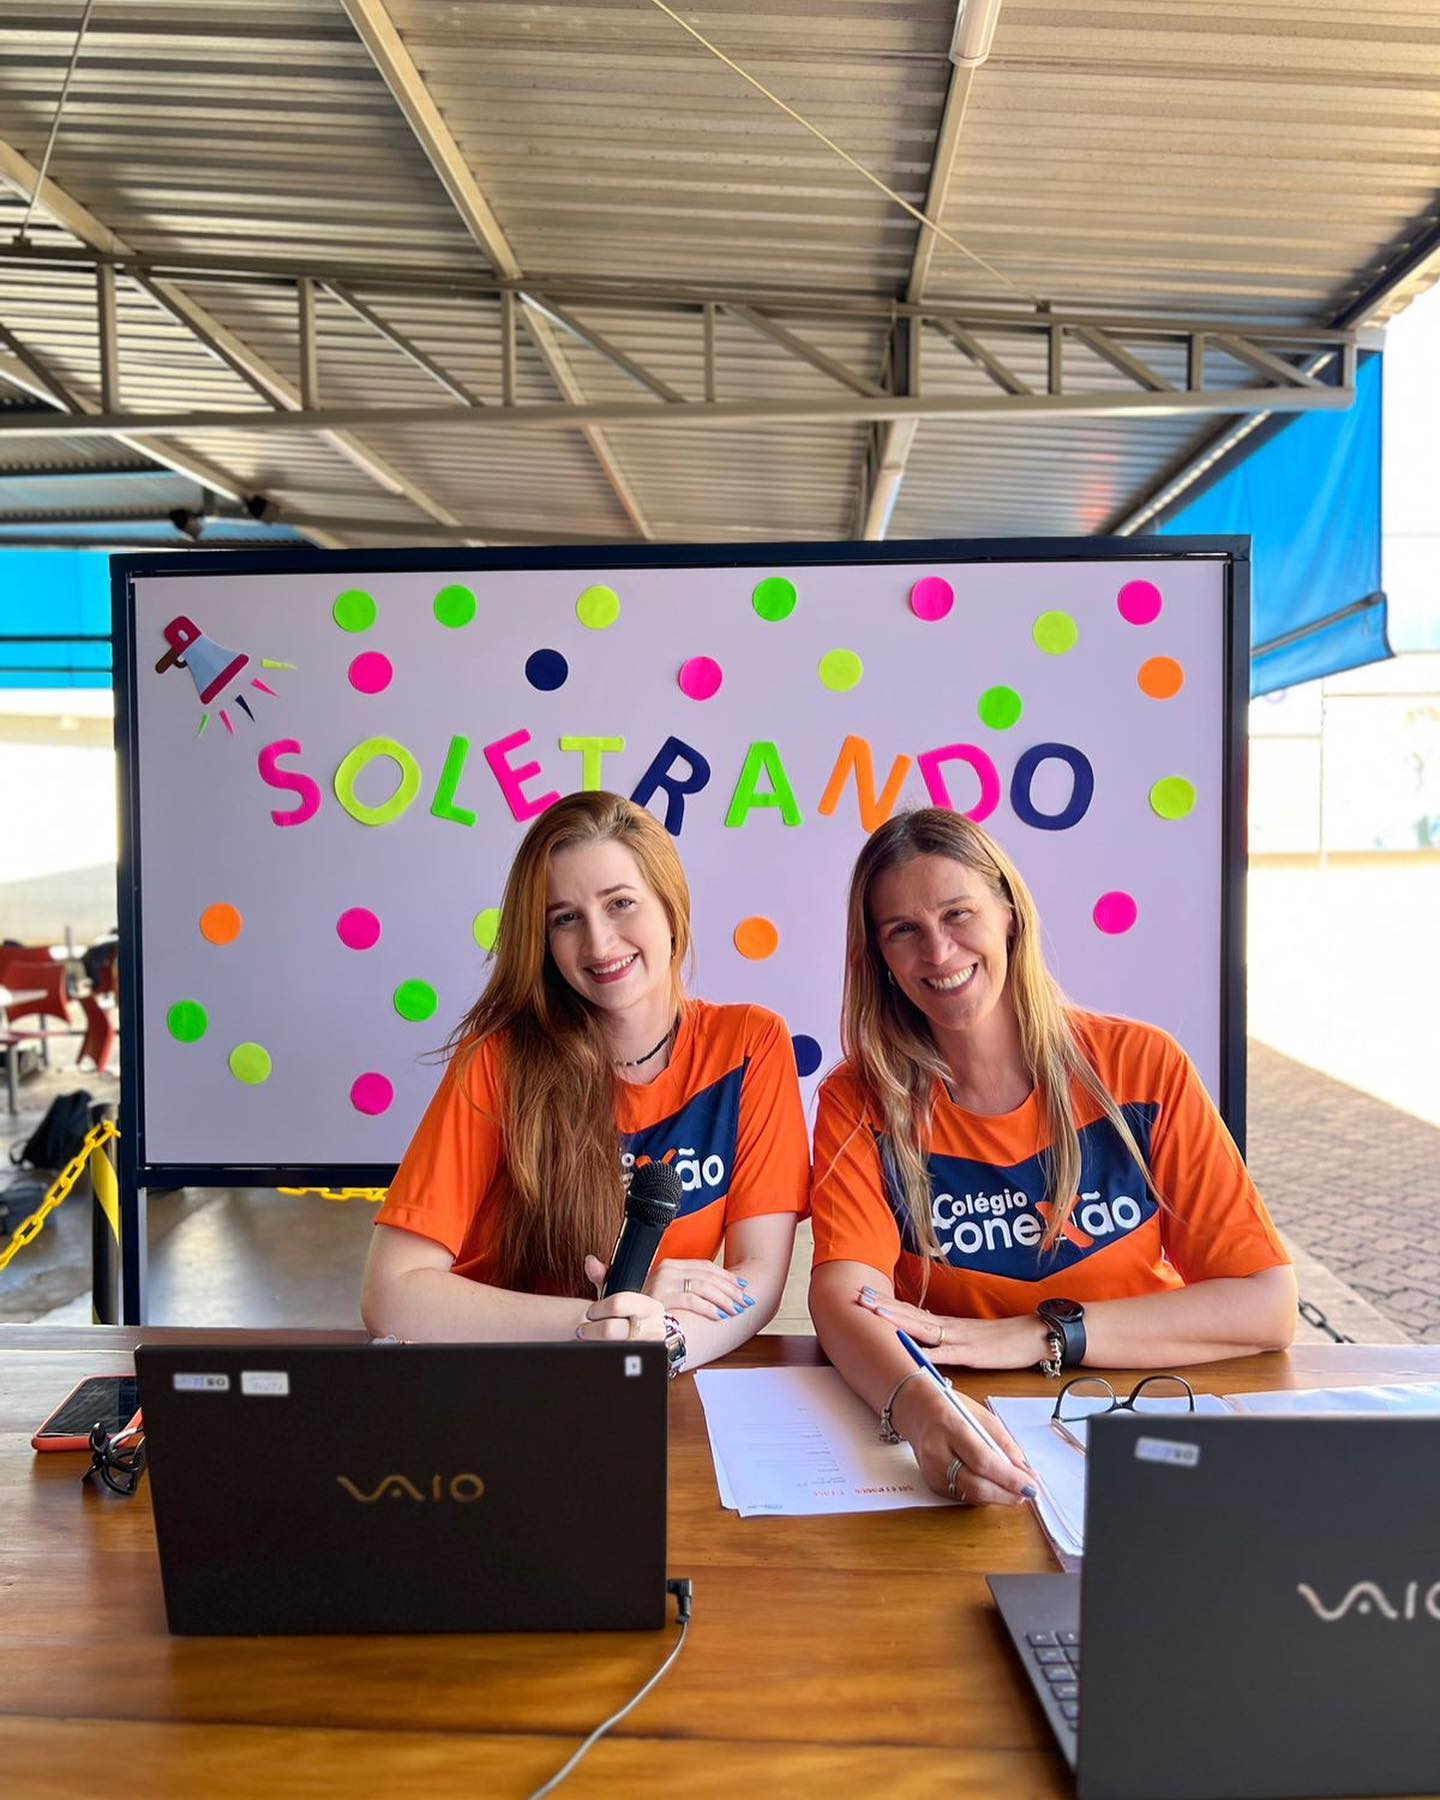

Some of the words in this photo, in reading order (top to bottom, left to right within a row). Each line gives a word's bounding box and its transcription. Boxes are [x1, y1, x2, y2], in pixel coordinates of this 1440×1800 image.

[257, 728, 1095, 836] SOLETRANDO
[932, 1189, 1028, 1223] Colégio
[336, 1473, 486, 1502] VAIO
